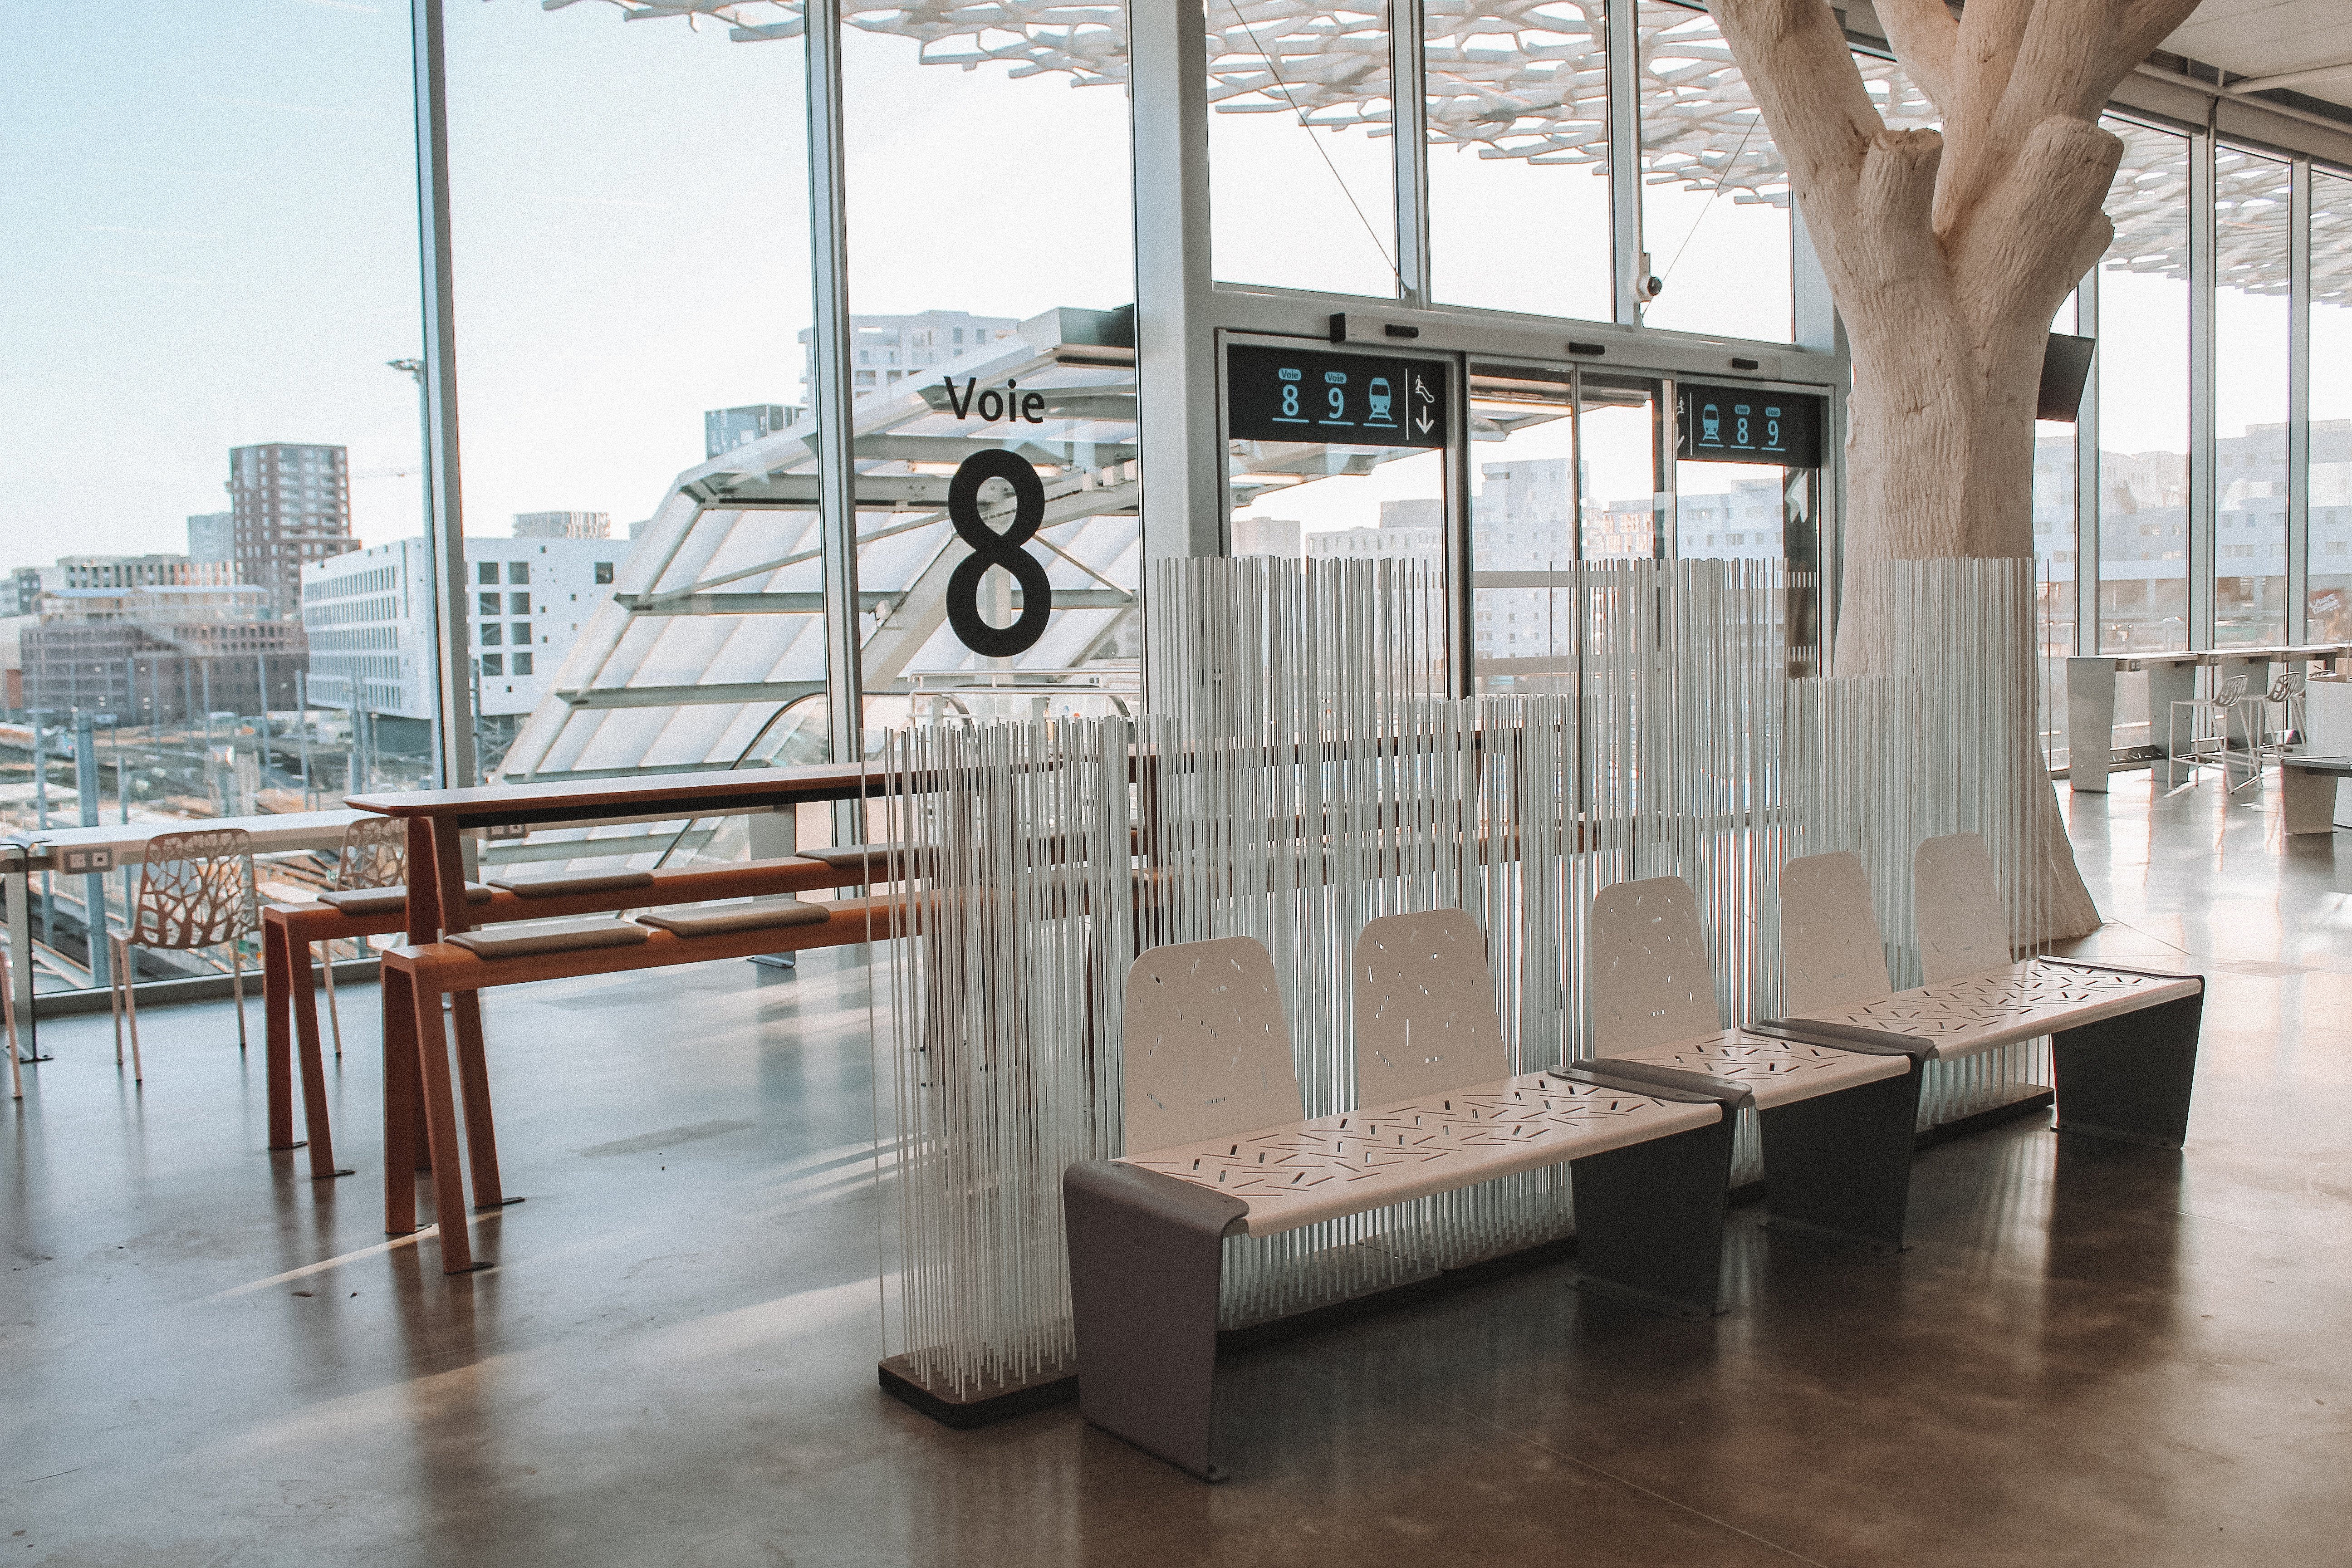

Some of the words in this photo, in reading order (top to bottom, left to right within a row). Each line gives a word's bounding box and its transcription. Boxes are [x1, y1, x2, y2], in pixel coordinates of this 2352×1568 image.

[1281, 370, 1298, 379] Voie
[1327, 373, 1344, 382] Voie
[944, 376, 1045, 423] Voie
[1283, 384, 1299, 416] 8
[1328, 387, 1344, 419] 9
[1737, 417, 1749, 444] 8
[1768, 420, 1779, 446] 9
[946, 448, 1051, 657] 8
